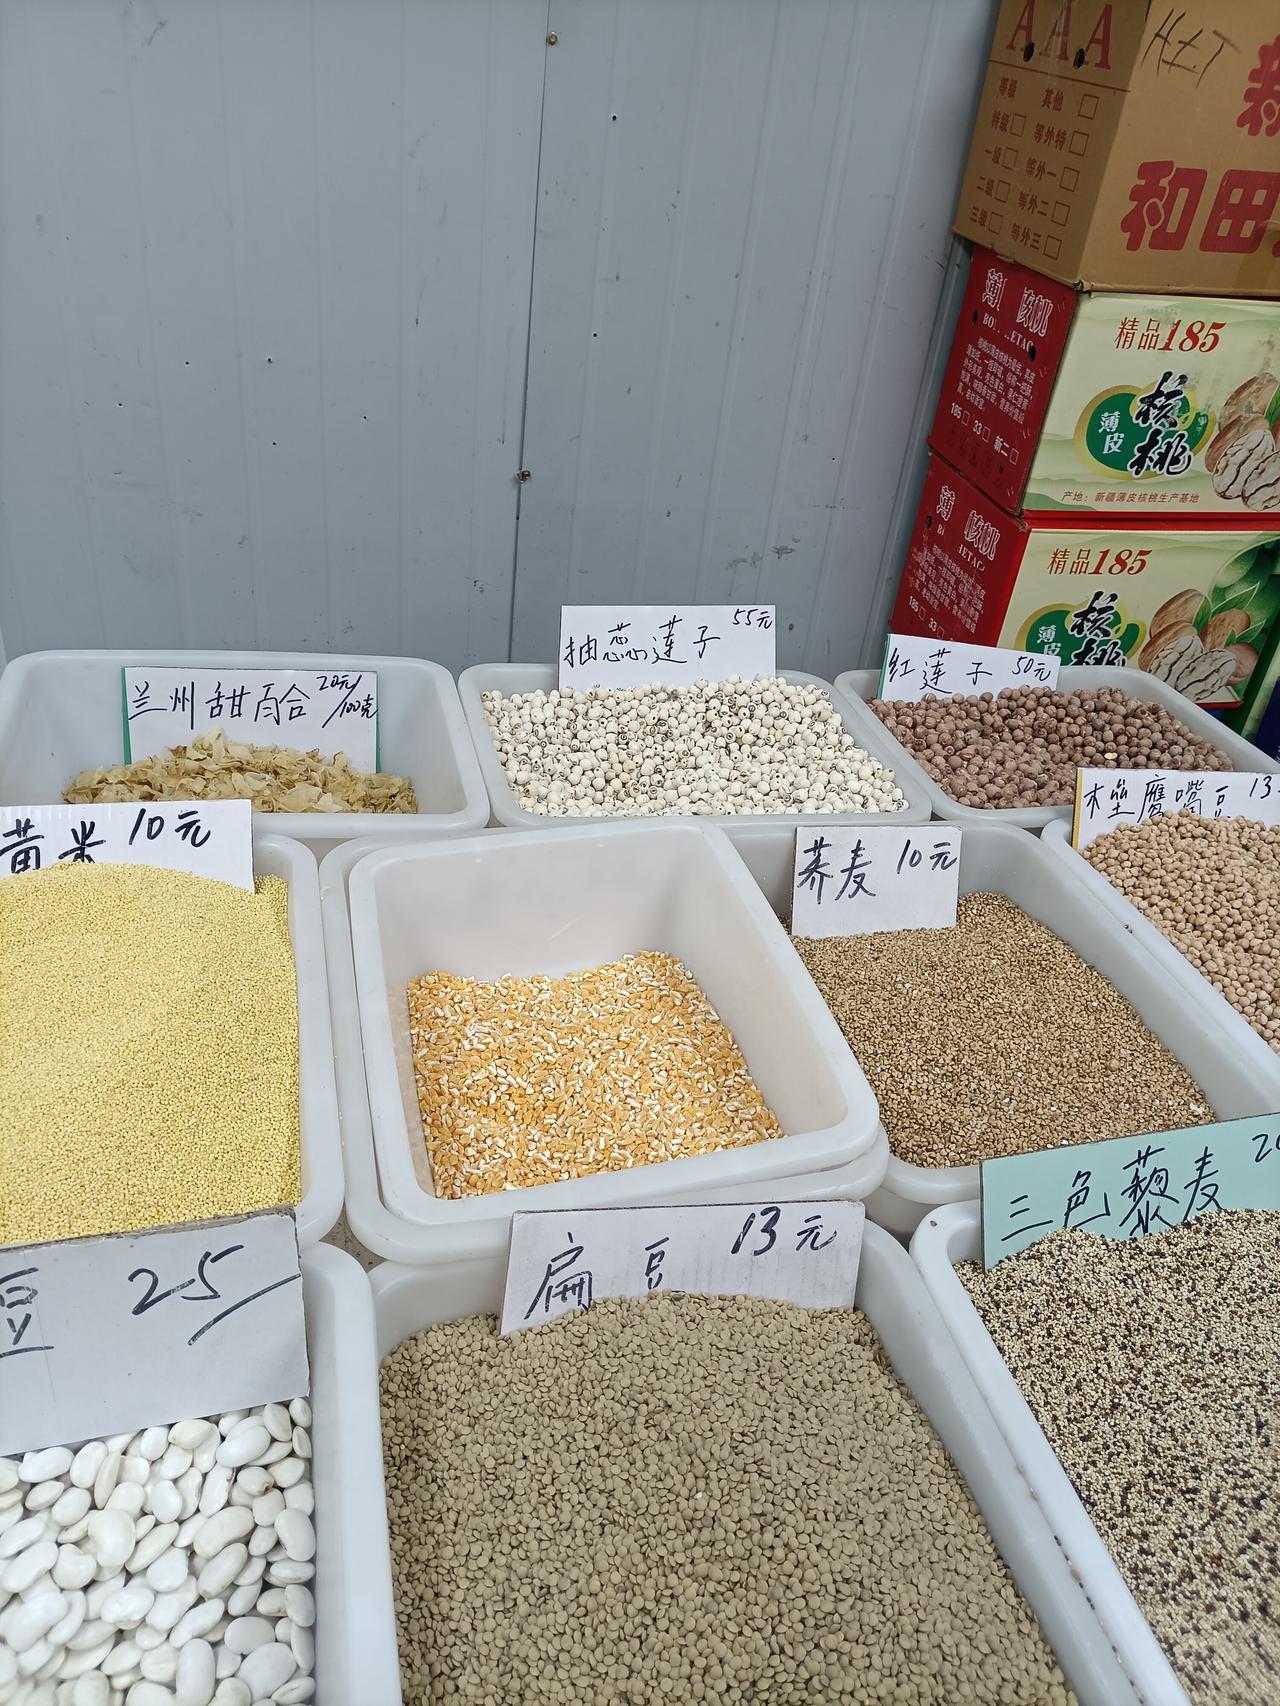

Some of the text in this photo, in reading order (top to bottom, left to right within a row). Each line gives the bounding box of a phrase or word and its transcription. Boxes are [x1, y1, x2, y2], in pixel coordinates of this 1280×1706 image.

[1000, 76, 1065, 112] 等级 其他
[991, 110, 1067, 151] 特级 等外特
[984, 145, 1057, 181] 一级 等外一
[976, 176, 1049, 217] 二级 等外二
[1120, 160, 1280, 257] 和田
[969, 205, 1042, 250] 三级 等外三
[1114, 316, 1227, 353] 精品185
[951, 402, 963, 419] 185
[972, 420, 983, 435] 33
[1098, 411, 1125, 455] 薄皮
[1127, 370, 1193, 477] 核桃
[1094, 491, 1200, 504] 新疆薄皮核桃生产基地
[1047, 548, 1153, 576] 精品185
[908, 596, 938, 632] 185 33
[563, 608, 773, 668] 抽蕊莲子 55元
[888, 647, 1052, 694] 红莲子 50元
[128, 680, 311, 730] 兰州甜百合
[1249, 775, 1280, 800] 13
[0, 808, 212, 874] 黄米 10元
[796, 836, 958, 905] 荞麦 10元
[1000, 1133, 1280, 1242] 三色藜麦 2
[523, 1205, 837, 1320] 扁豆 13元
